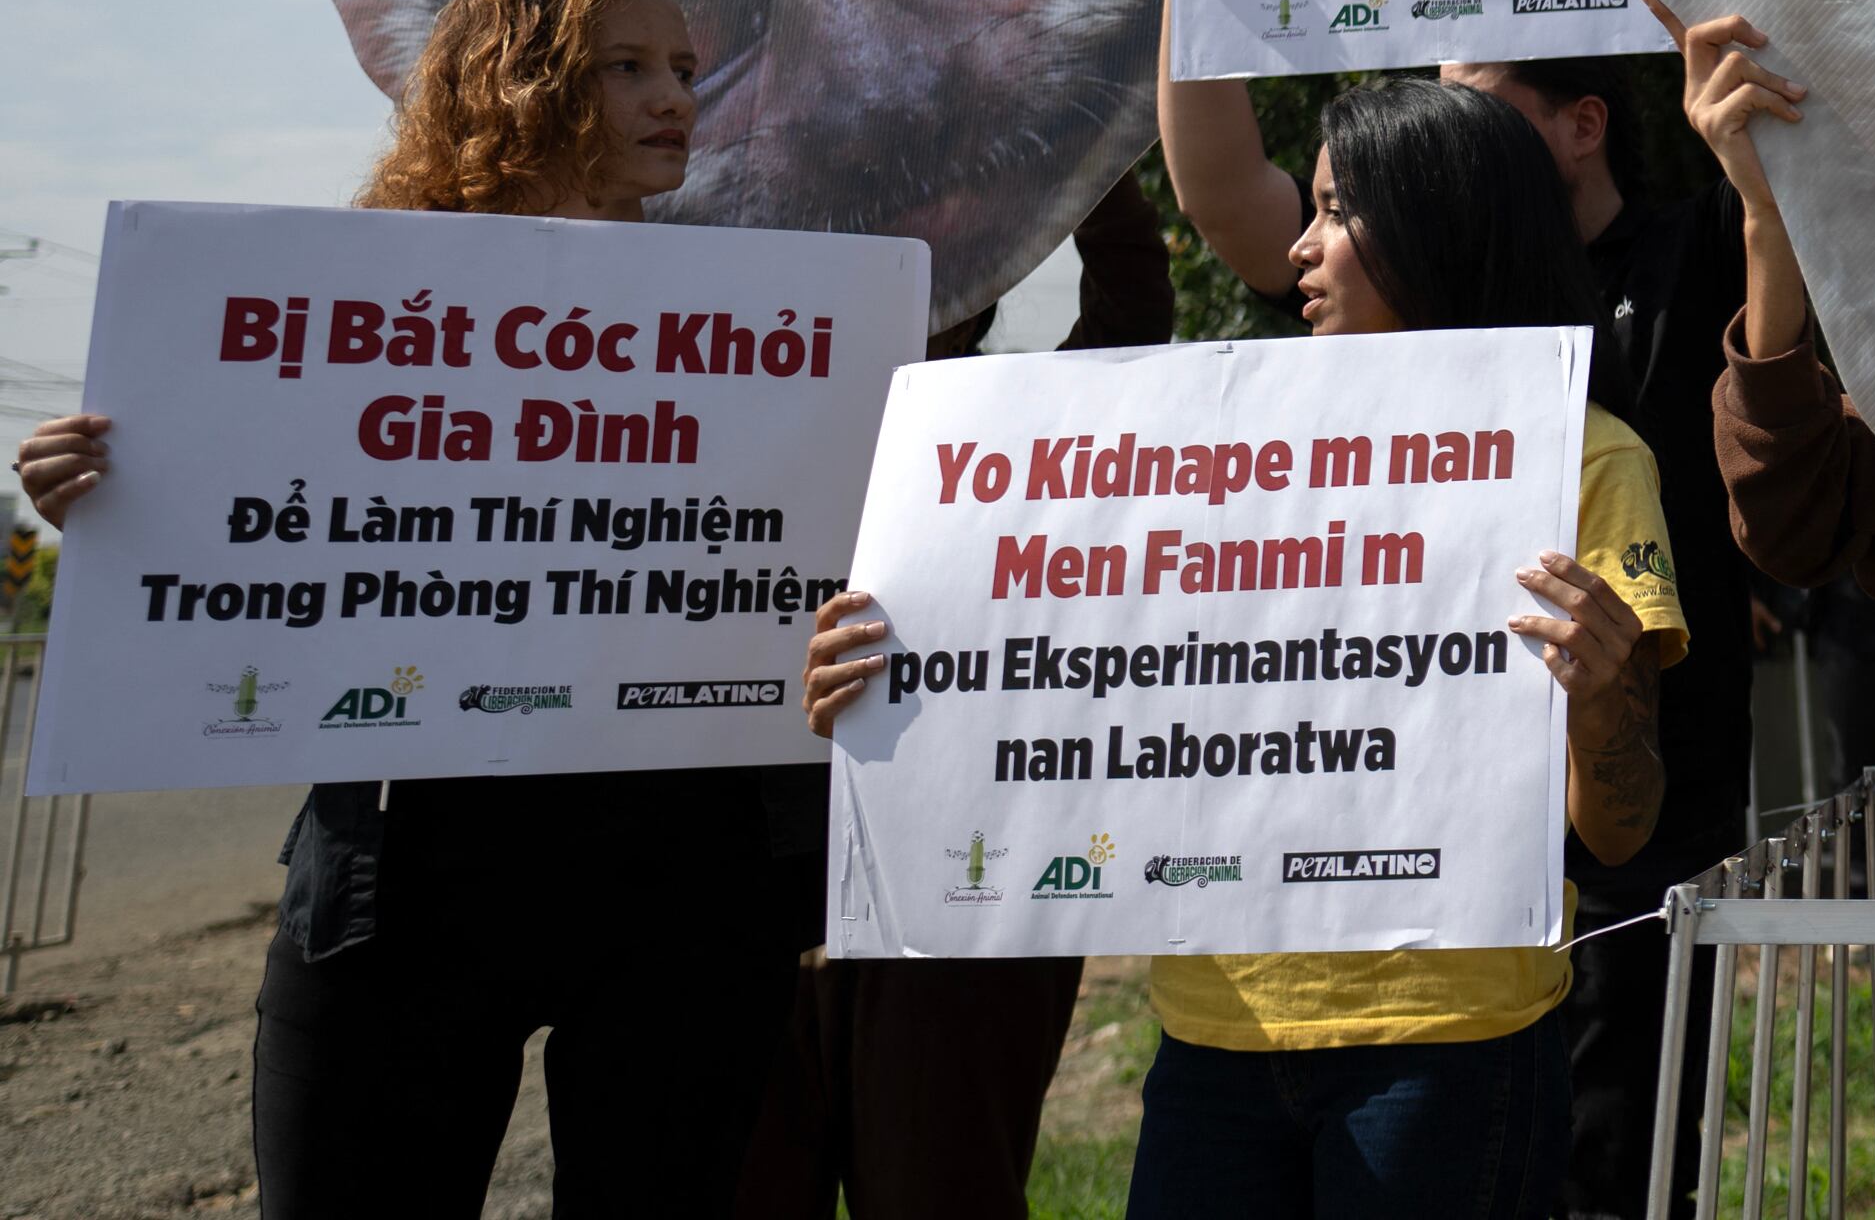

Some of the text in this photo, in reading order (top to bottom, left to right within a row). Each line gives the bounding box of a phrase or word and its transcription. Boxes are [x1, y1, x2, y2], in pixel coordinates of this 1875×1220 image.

[220, 289, 833, 379] Bị Bắt Cóc Khỏi
[359, 395, 699, 464] Gia Đình
[936, 429, 1514, 505] Yo Kidnape m nan
[228, 478, 783, 555] Để Làm Thí Nghiệm
[991, 521, 1424, 600] Men Fanmi m
[142, 573, 324, 628] Trong
[340, 570, 530, 625] Phòng
[546, 568, 635, 615] Thí
[889, 631, 1507, 704] pou Eksperimantasyon
[534, 694, 572, 708] ANIMAL
[995, 722, 1396, 781] nan Laboratwa
[1172, 856, 1241, 866] FEDERACION DE
[1208, 865, 1242, 882] ANIMAL
[977, 892, 1003, 902] Animal
